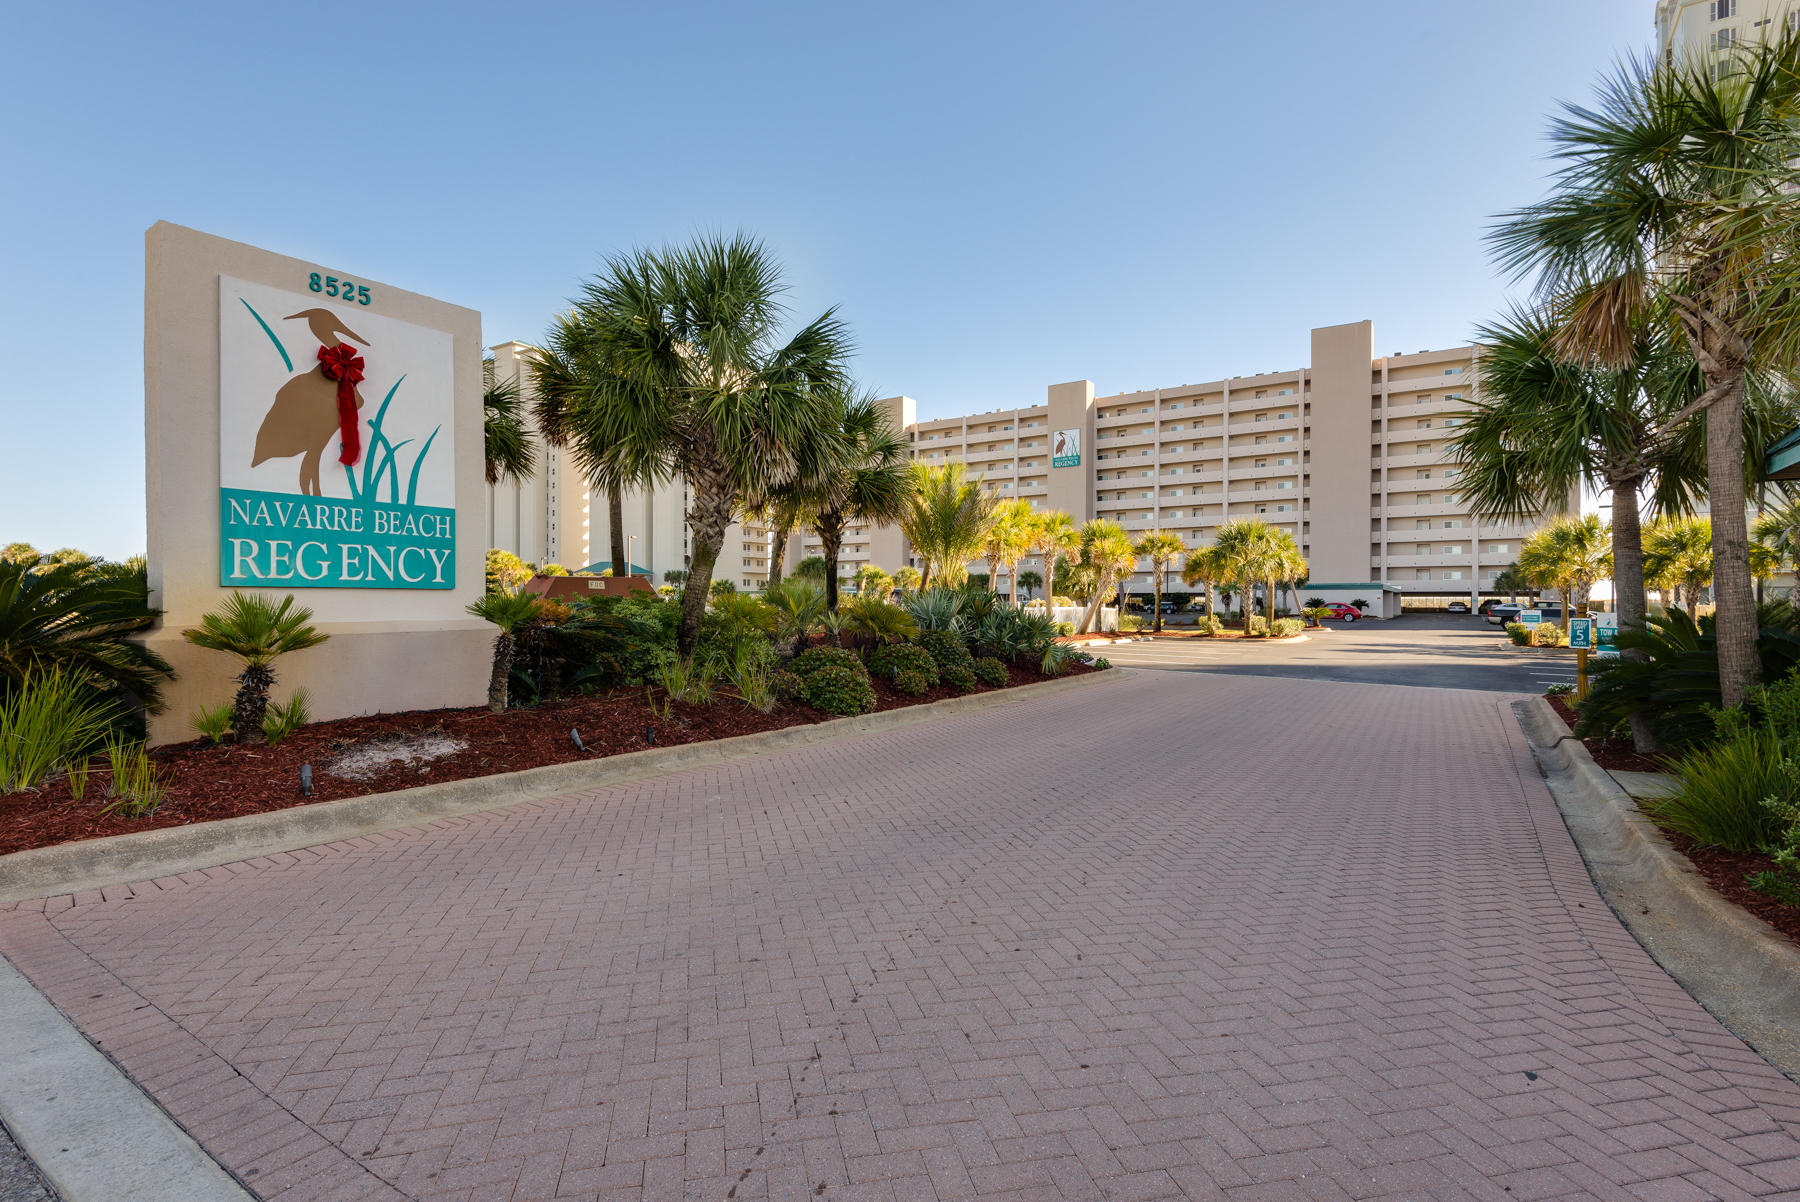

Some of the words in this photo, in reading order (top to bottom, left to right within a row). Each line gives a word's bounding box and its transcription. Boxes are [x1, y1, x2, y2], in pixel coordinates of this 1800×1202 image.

[309, 272, 371, 305] 8525
[228, 498, 364, 533] NAVARRE
[373, 508, 452, 538] BEACH
[229, 537, 451, 583] REGENCY
[1576, 630, 1584, 640] 5
[1599, 629, 1613, 637] TOW
